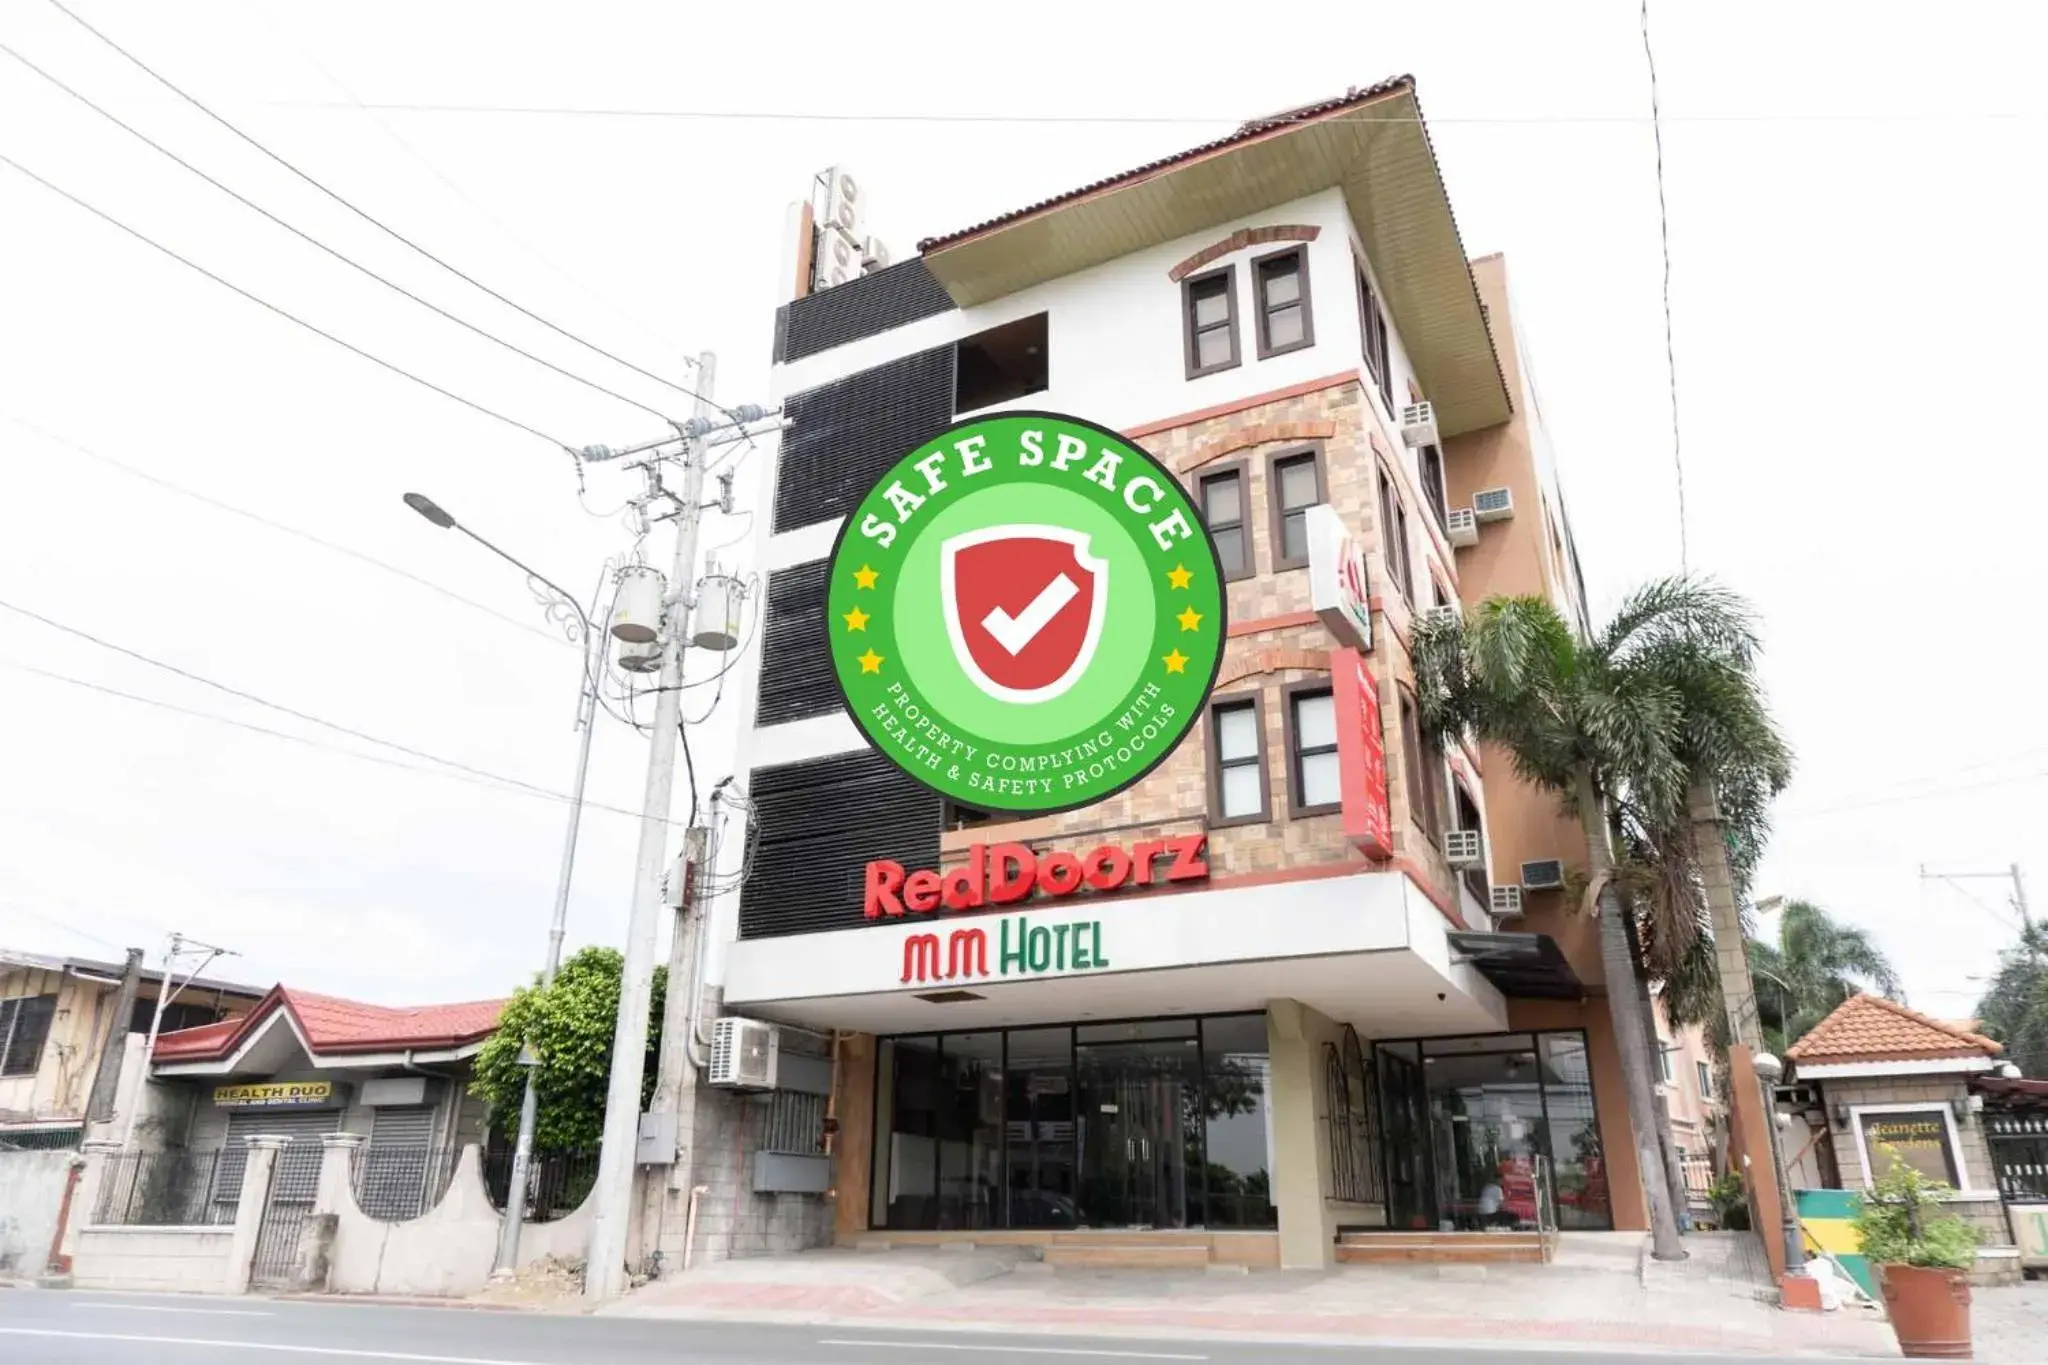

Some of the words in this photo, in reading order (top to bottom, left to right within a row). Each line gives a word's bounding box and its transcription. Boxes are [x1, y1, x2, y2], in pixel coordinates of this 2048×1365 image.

[864, 833, 1208, 920] RedDoorz
[216, 1087, 284, 1099] HEALTH
[289, 1085, 327, 1096] DUO
